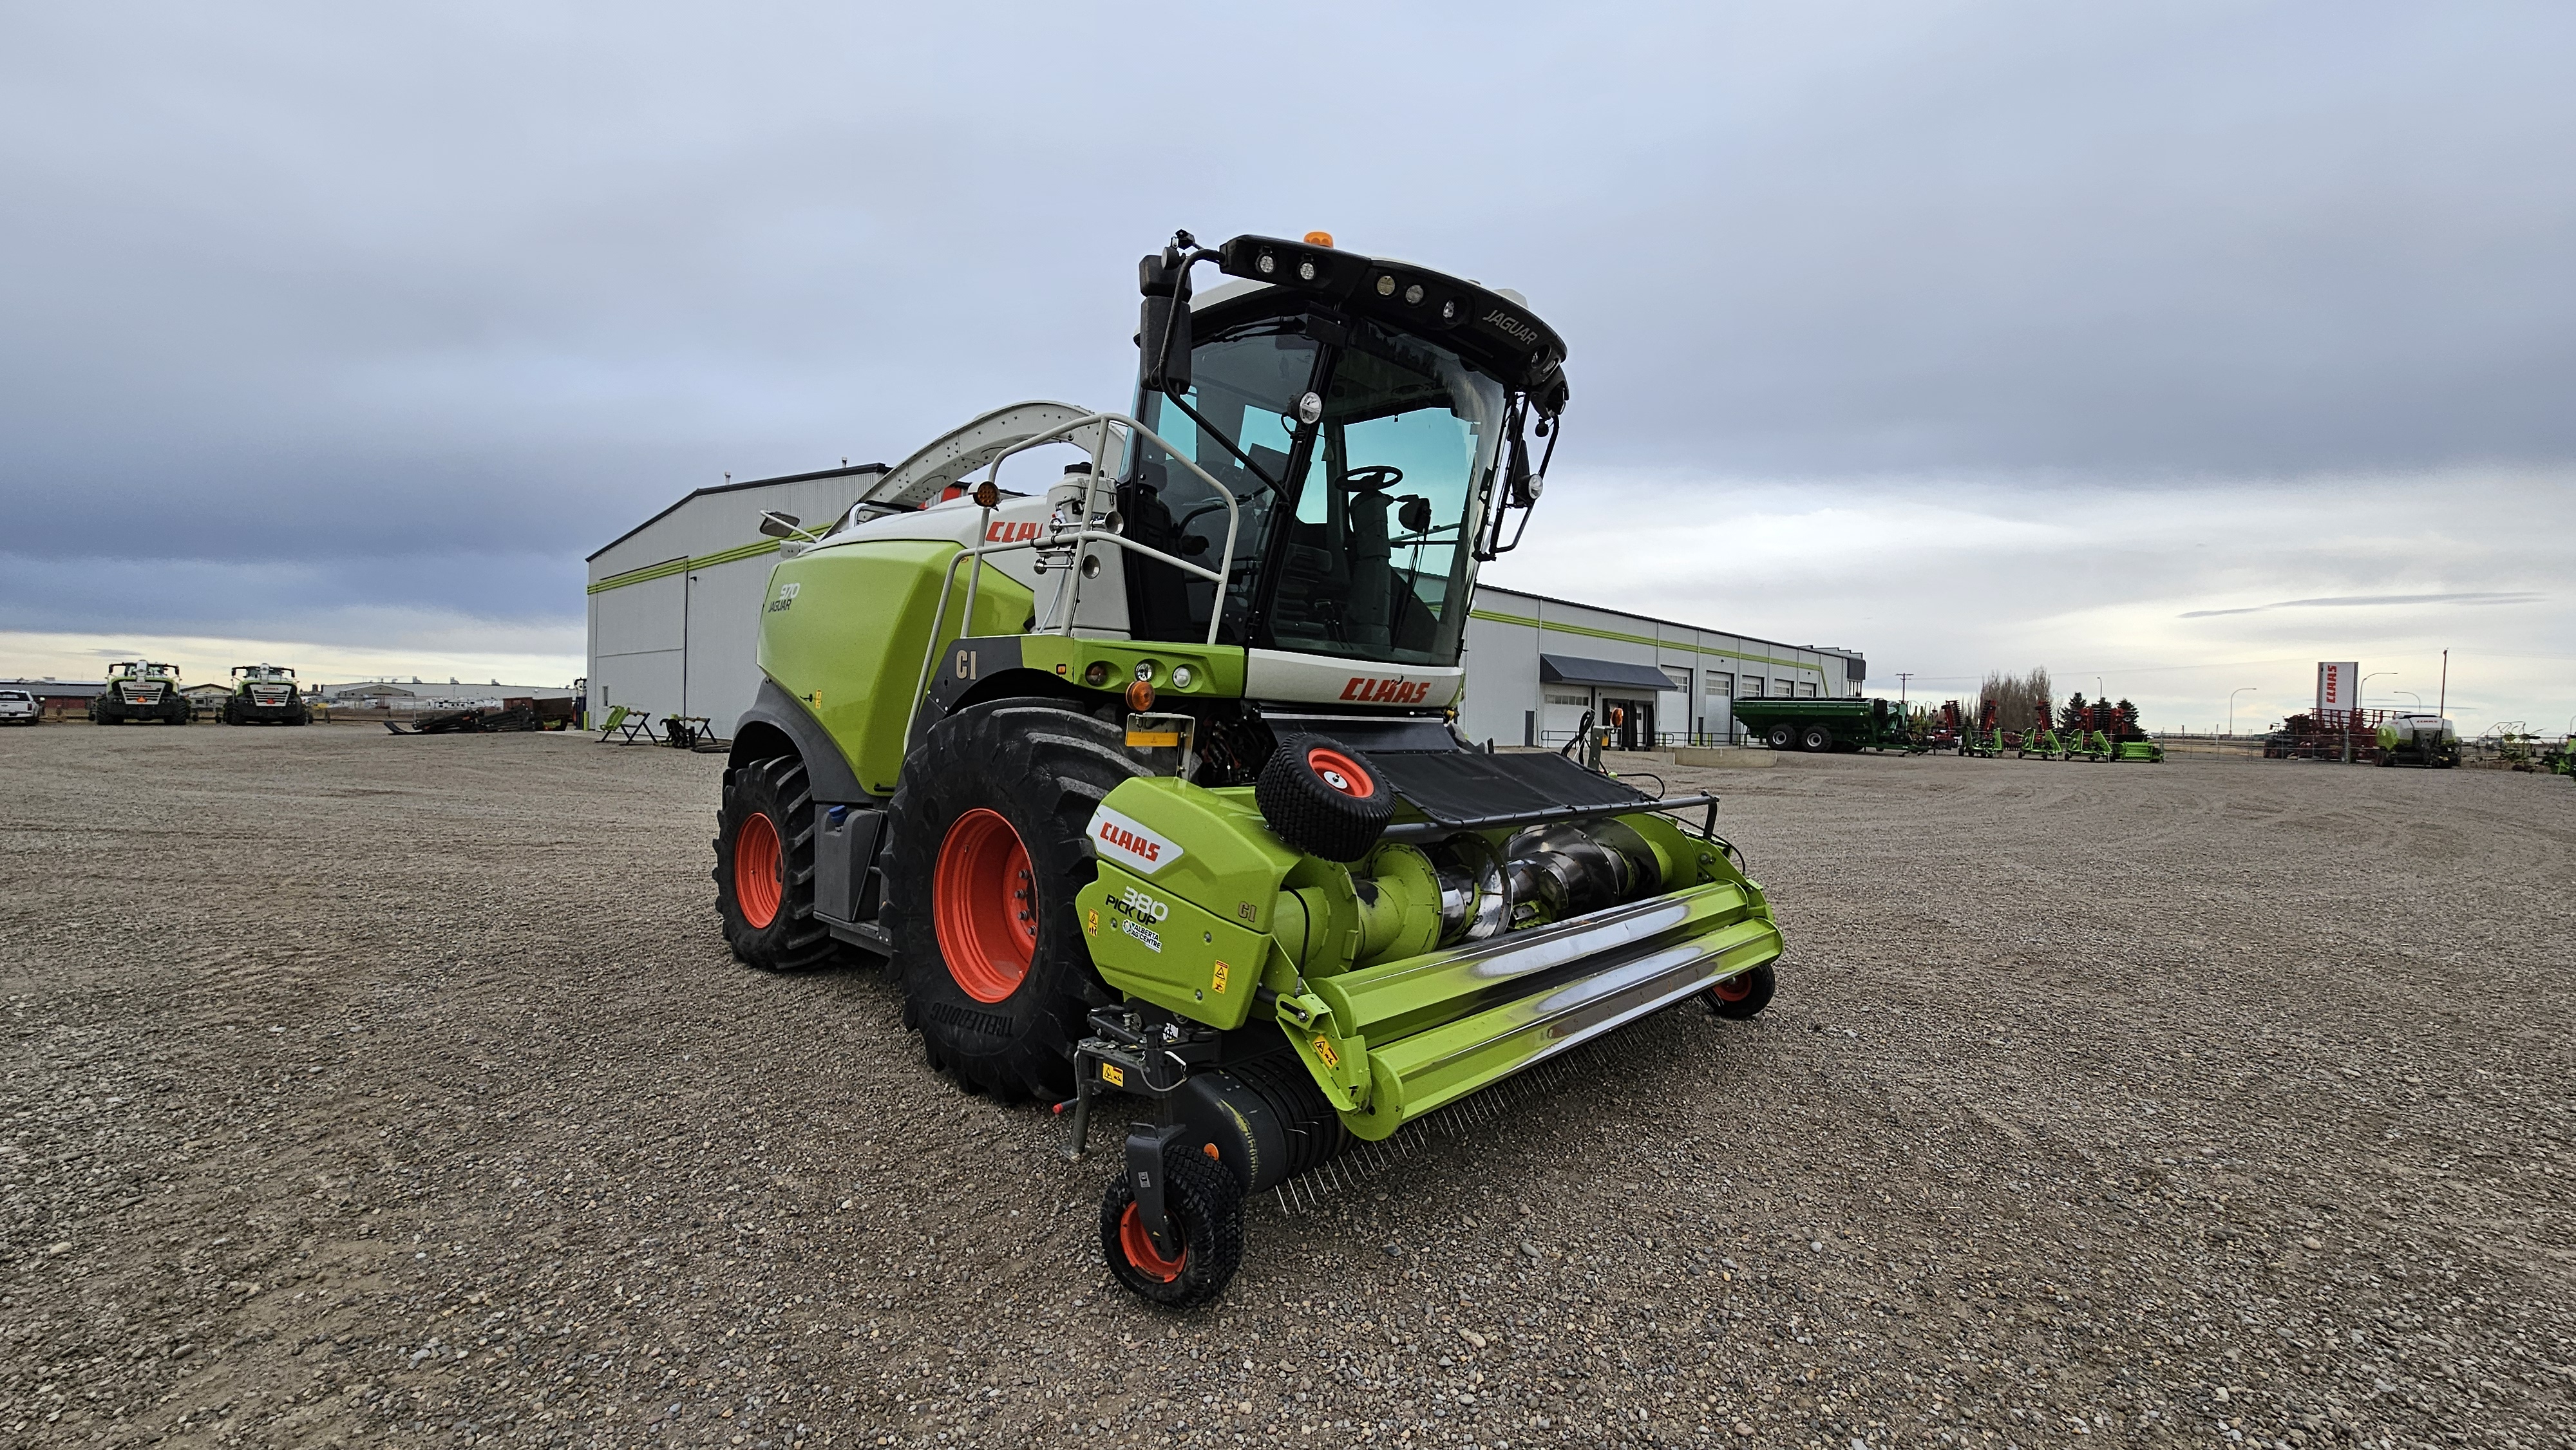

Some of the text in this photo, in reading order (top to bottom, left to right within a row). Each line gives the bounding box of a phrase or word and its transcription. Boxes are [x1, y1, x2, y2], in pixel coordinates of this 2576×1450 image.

[1482, 310, 1538, 344] JAGUAR
[986, 522, 1043, 542] CLA
[779, 582, 800, 600] 970
[768, 599, 791, 613] JAGUAR
[1340, 678, 1431, 704] CLAAS
[2326, 665, 2337, 703] CLAAS
[1100, 822, 1160, 862] CLAAS
[1105, 894, 1157, 926] PICK UP
[1122, 885, 1169, 921] 380
[1134, 925, 1159, 940] ALBERTA
[1139, 934, 1161, 948] CENTRE
[929, 1002, 1016, 1037] TRELLEBORG
